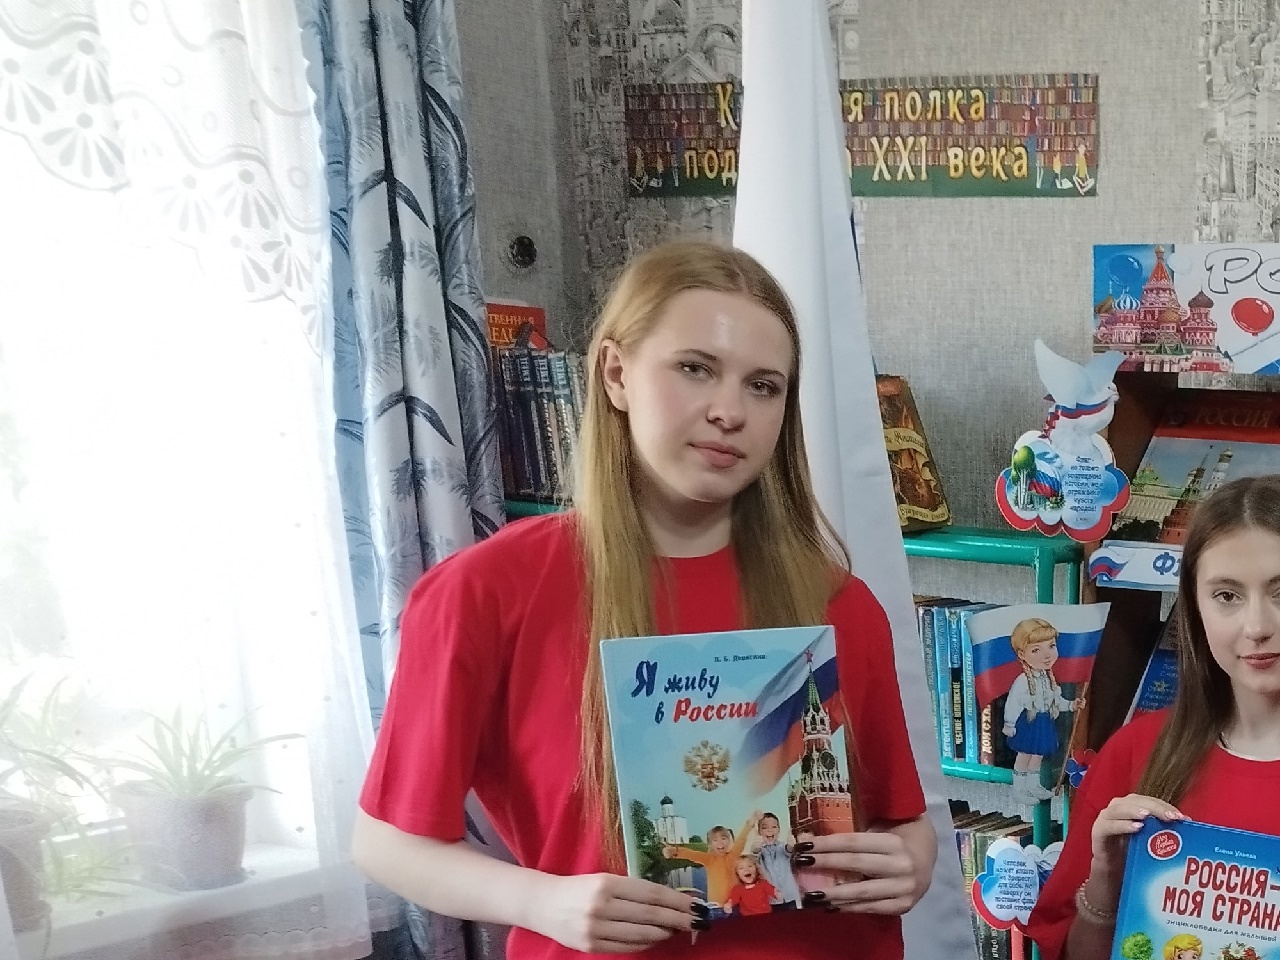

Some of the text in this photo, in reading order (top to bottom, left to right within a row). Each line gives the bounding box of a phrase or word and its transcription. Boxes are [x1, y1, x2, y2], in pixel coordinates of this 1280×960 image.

[884, 88, 985, 125] полка
[870, 135, 928, 182] XXI
[949, 143, 1029, 182] века
[1193, 406, 1273, 428] РОССИЯ
[631, 660, 720, 698] Я живу
[655, 697, 759, 724] в России
[1162, 886, 1205, 918] МОЯ
